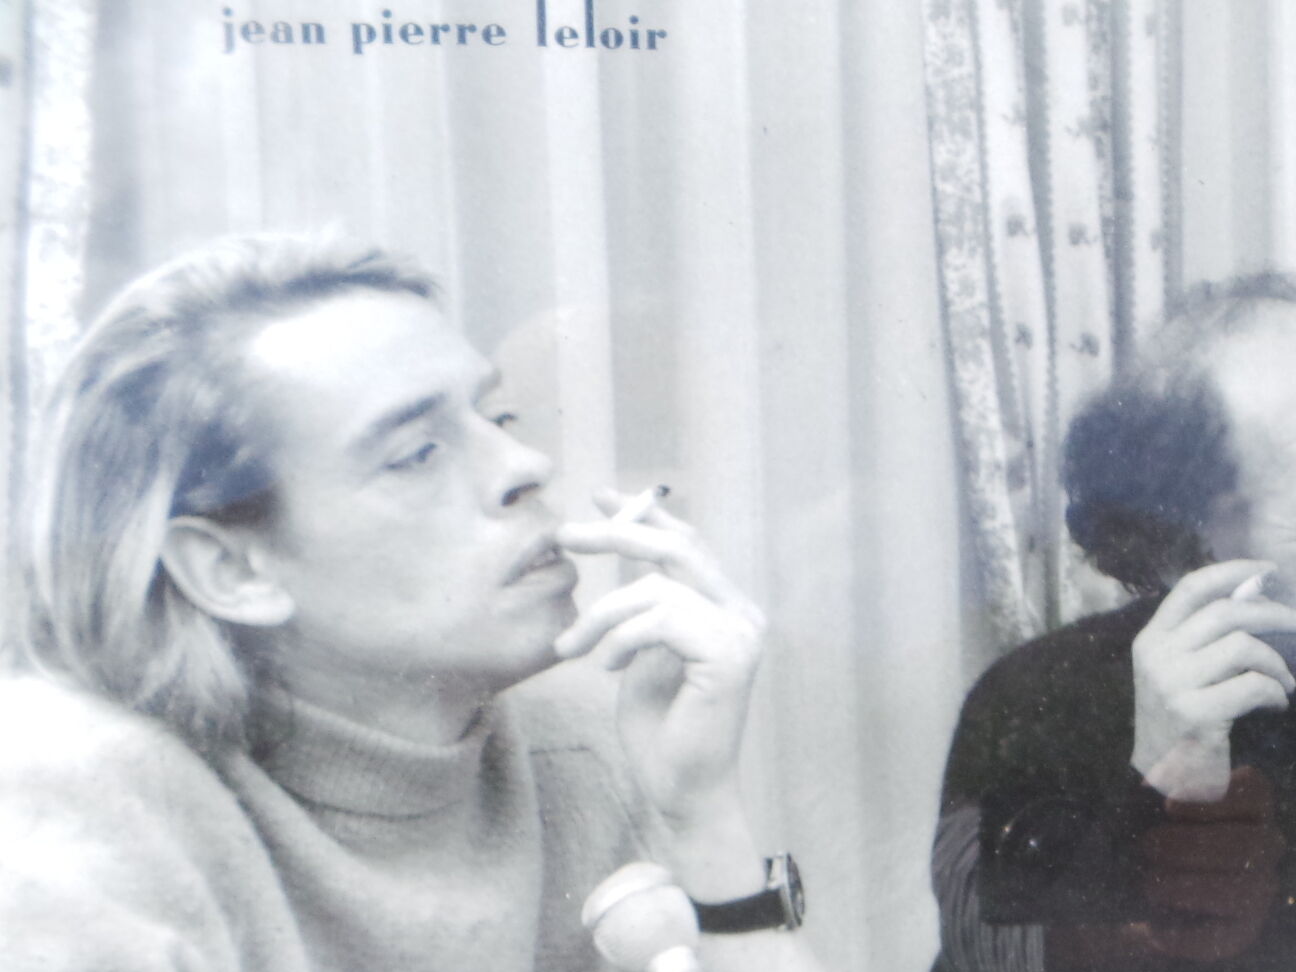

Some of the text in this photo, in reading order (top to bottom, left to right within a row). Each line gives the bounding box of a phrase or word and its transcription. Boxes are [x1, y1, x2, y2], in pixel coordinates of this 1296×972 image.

[221, 0, 668, 55] jean pierre leloir
